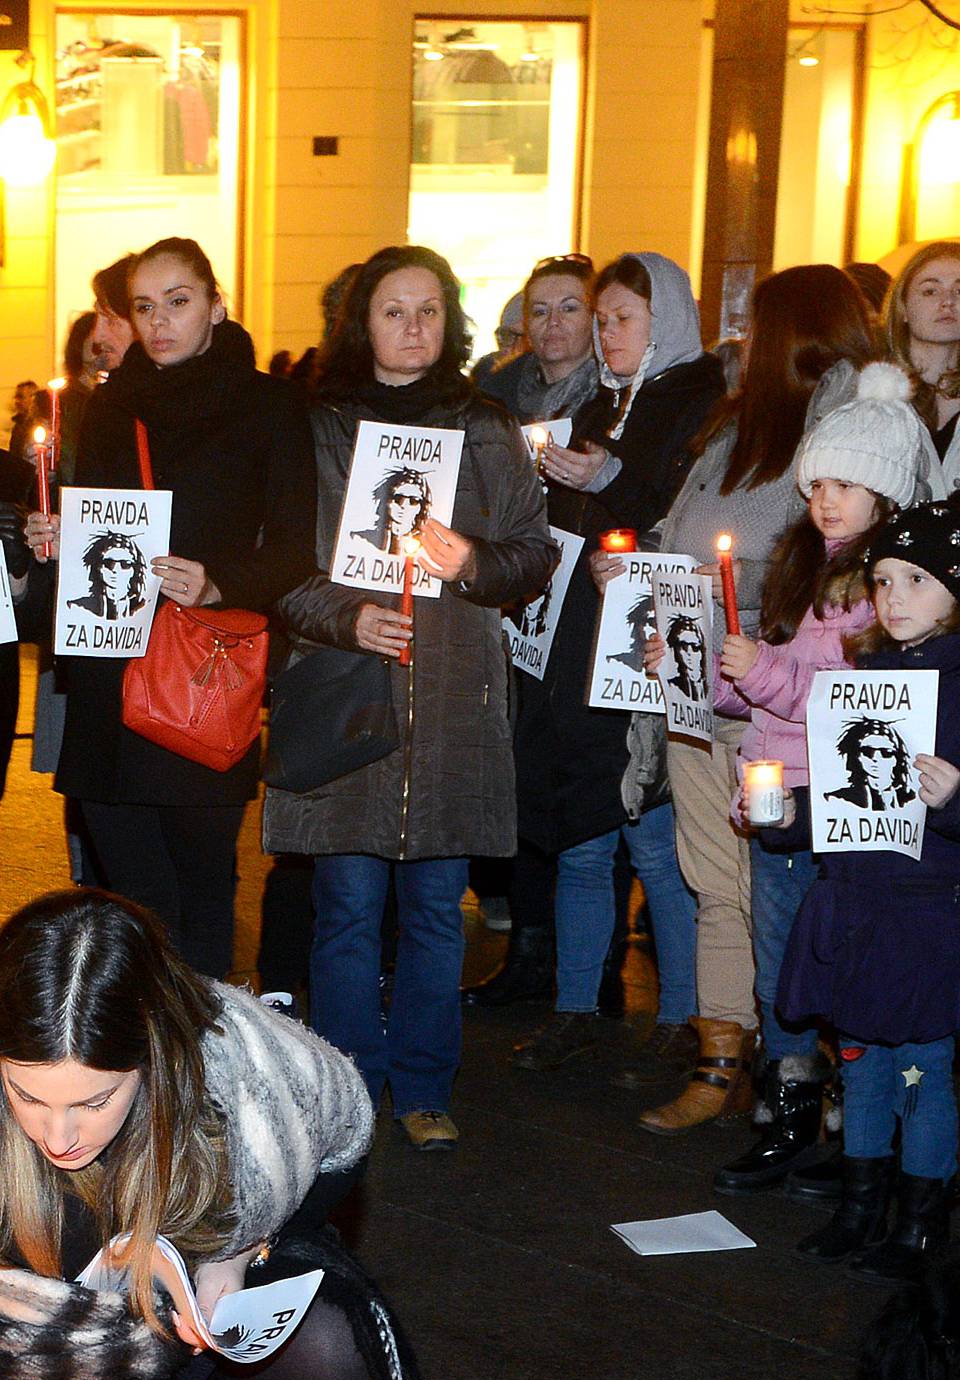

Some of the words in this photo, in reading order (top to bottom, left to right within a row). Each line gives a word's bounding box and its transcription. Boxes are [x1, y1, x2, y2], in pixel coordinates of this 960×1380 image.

[377, 434, 443, 464] PRAVDA
[81, 499, 149, 526] PRAVDA
[343, 554, 366, 581] ZA
[371, 558, 432, 589] DAVDA
[659, 582, 704, 610] PRAVDA
[66, 624, 88, 649] ZA
[93, 625, 144, 650] DAVIDA
[511, 636, 545, 672] DAVIDA
[601, 678, 625, 702] ZA
[629, 681, 666, 704] DAV
[830, 683, 912, 711] PRAVDA
[672, 702, 688, 727] ZA
[826, 818, 854, 844] ZA
[859, 817, 921, 850] DAVIDA
